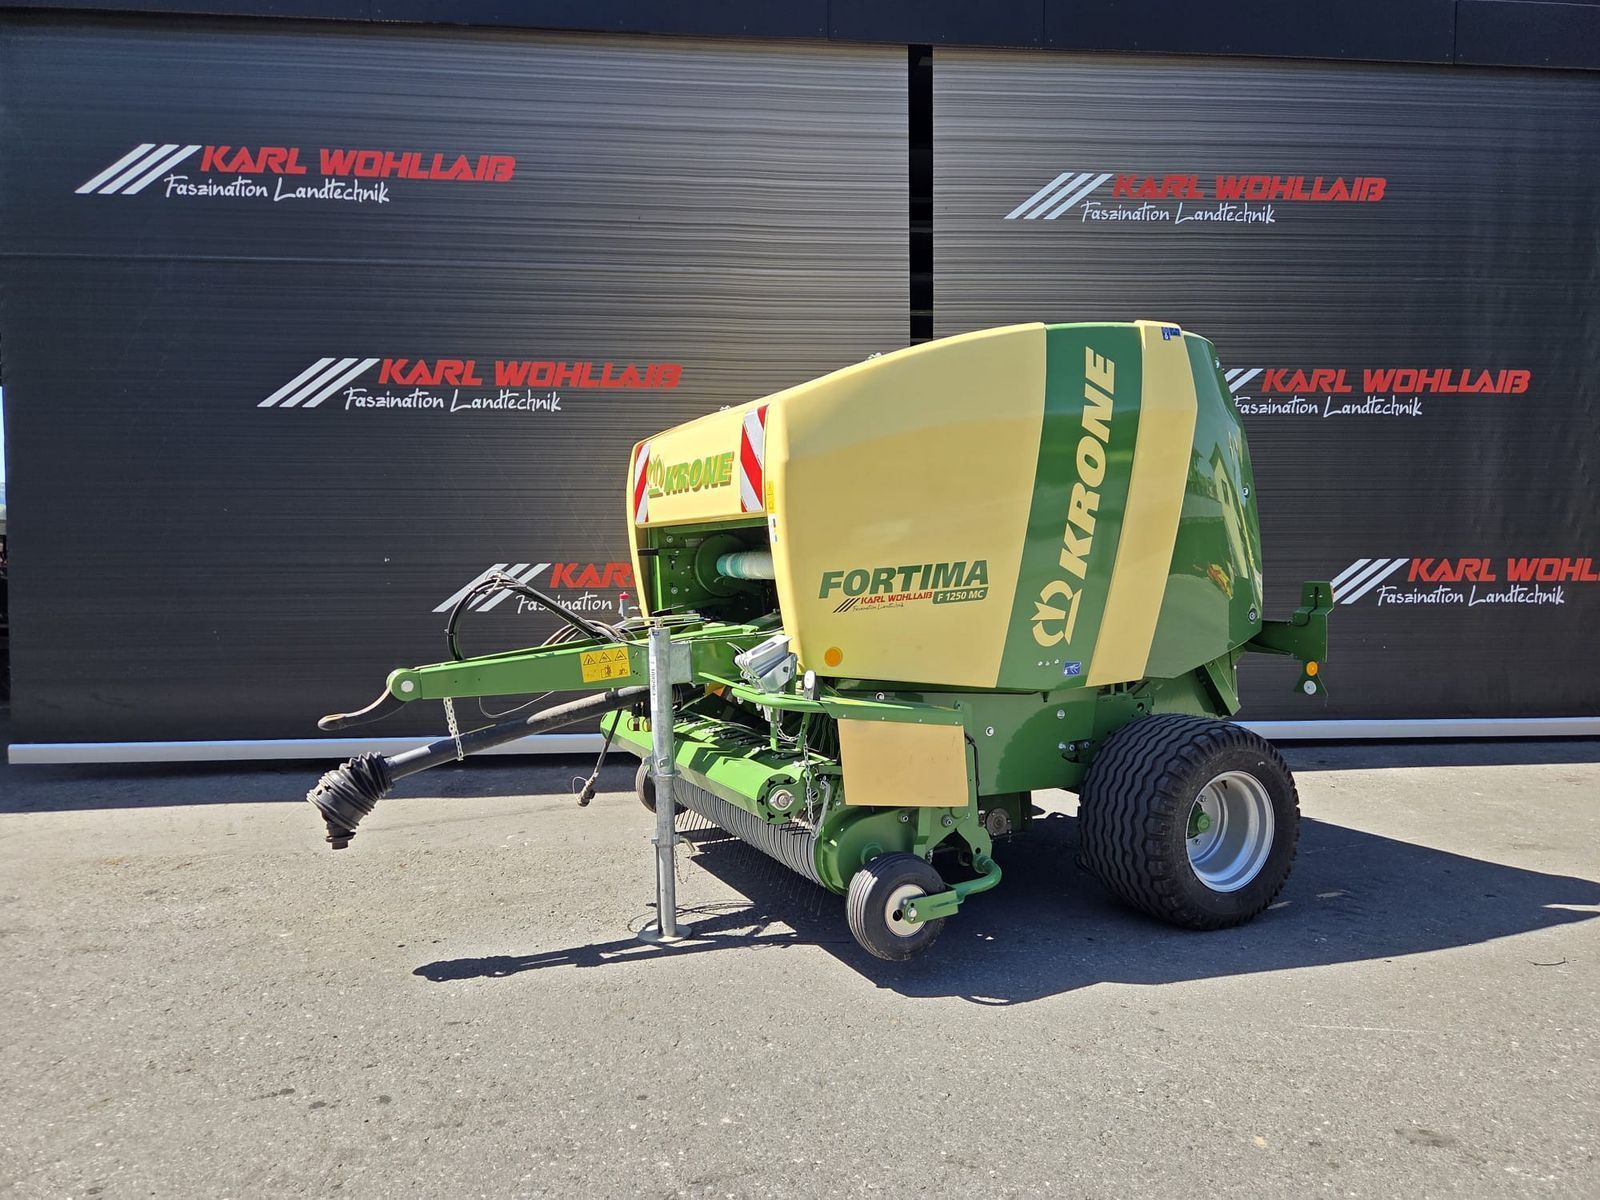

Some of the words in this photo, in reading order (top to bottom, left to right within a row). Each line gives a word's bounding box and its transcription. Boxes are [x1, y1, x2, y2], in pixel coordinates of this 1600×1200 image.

[201, 146, 308, 175] KARL
[320, 149, 516, 182] WOHLLAIB
[164, 174, 268, 198] Faszination
[274, 177, 390, 203] Landtechnik
[1112, 174, 1204, 200] KARL
[1215, 175, 1387, 202] WOHLLAIB
[1081, 201, 1170, 223] Faszination
[1175, 202, 1276, 225] Landtechnik
[378, 358, 482, 386] KARL
[495, 360, 683, 390] WOHLLAIB
[1262, 368, 1352, 393] KARL
[1363, 368, 1531, 394] WOHLLAIB
[343, 386, 444, 411] Faszination
[450, 388, 562, 413] Landtechnik
[1323, 396, 1423, 418] Landtechnik
[663, 451, 735, 496] KRONE
[1059, 346, 1115, 580] KRONE
[818, 559, 989, 600] FORTIMA
[1408, 558, 1496, 582] KARL
[1507, 557, 1600, 581] WOHL
[515, 591, 612, 614] Fasination
[860, 594, 886, 605] KARL
[887, 591, 933, 603] WOHLLAIB
[936, 593, 944, 602] F
[945, 591, 967, 602] 1250
[968, 589, 985, 600] MC
[1377, 585, 1463, 606] Faszination
[1468, 584, 1565, 607] Landtechnik
